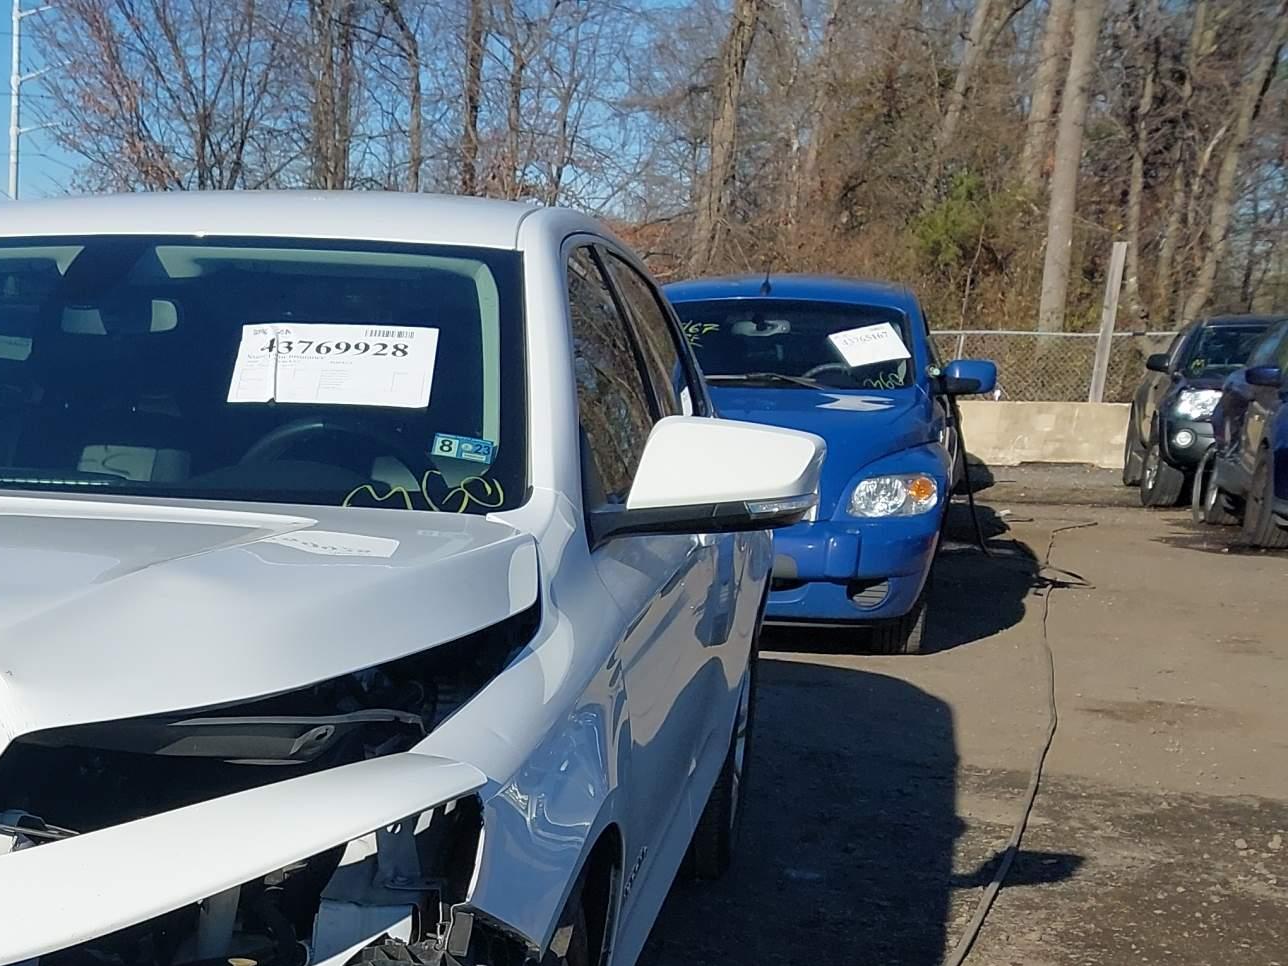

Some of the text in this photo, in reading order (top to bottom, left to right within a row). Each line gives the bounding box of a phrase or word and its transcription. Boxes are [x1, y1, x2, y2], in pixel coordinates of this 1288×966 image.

[260, 338, 410, 359] 43769928
[439, 439, 491, 456] 8 23
